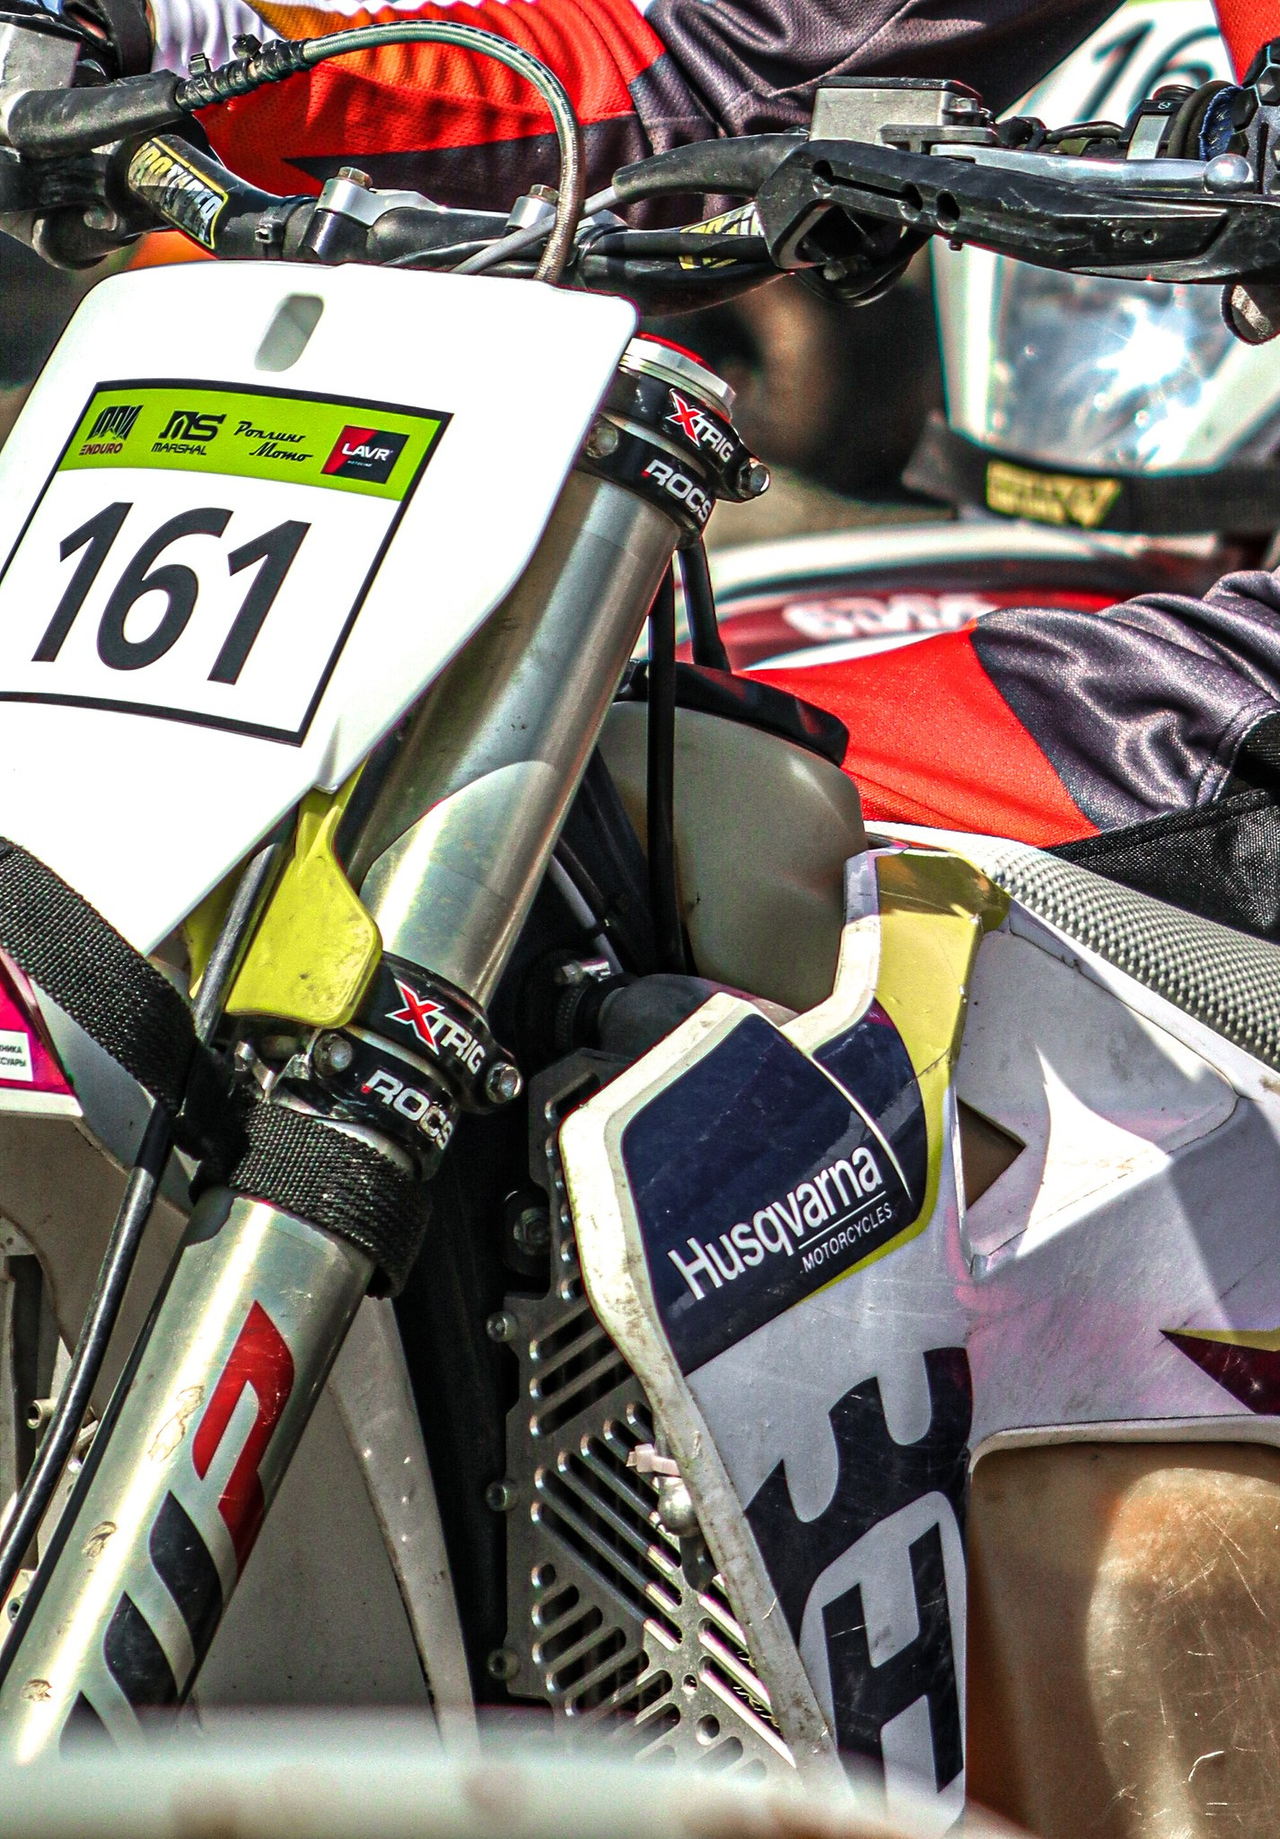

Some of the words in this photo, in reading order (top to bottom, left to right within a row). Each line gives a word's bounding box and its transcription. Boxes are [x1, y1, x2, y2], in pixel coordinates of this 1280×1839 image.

[79, 442, 124, 456] ENDURO
[151, 442, 208, 456] MARSHAL
[341, 442, 390, 461] LAVR
[664, 387, 735, 463] XTRIG
[31, 501, 312, 685] 161
[384, 977, 487, 1076] XTRIG
[667, 1146, 884, 1301] Husqvarna
[801, 1201, 893, 1274] MOTORCYCLES
